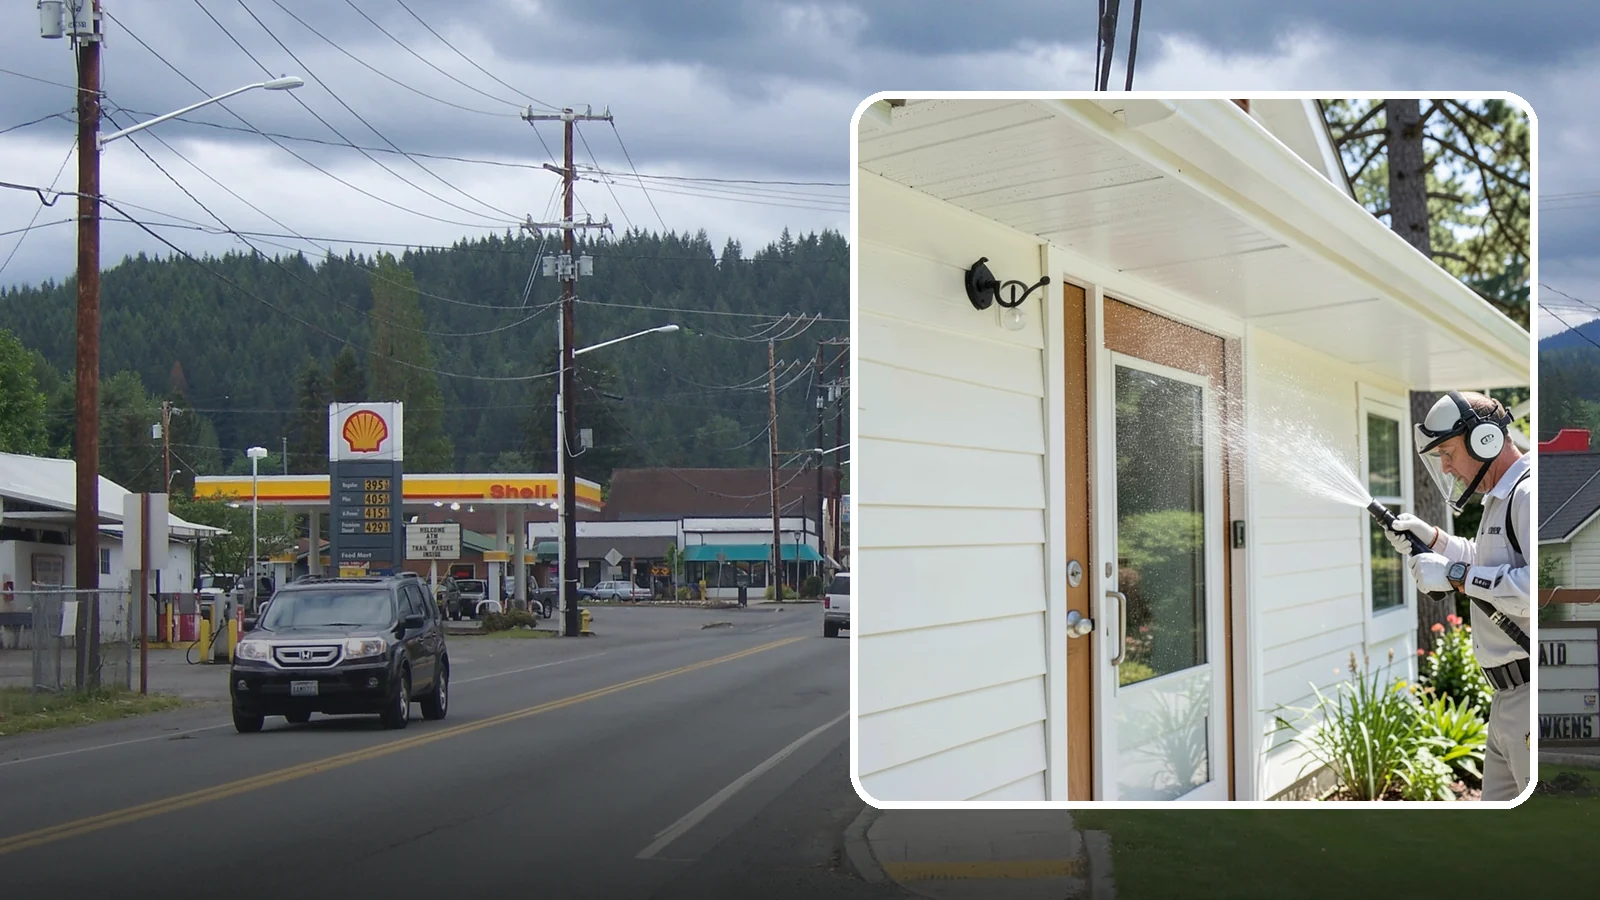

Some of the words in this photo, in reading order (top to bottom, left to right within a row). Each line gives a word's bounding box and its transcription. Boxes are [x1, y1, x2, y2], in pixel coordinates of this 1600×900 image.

[366, 480, 383, 490] 395
[490, 484, 547, 499] Shell
[366, 494, 383, 504] 405
[366, 508, 383, 518] 415
[366, 522, 383, 532] 429
